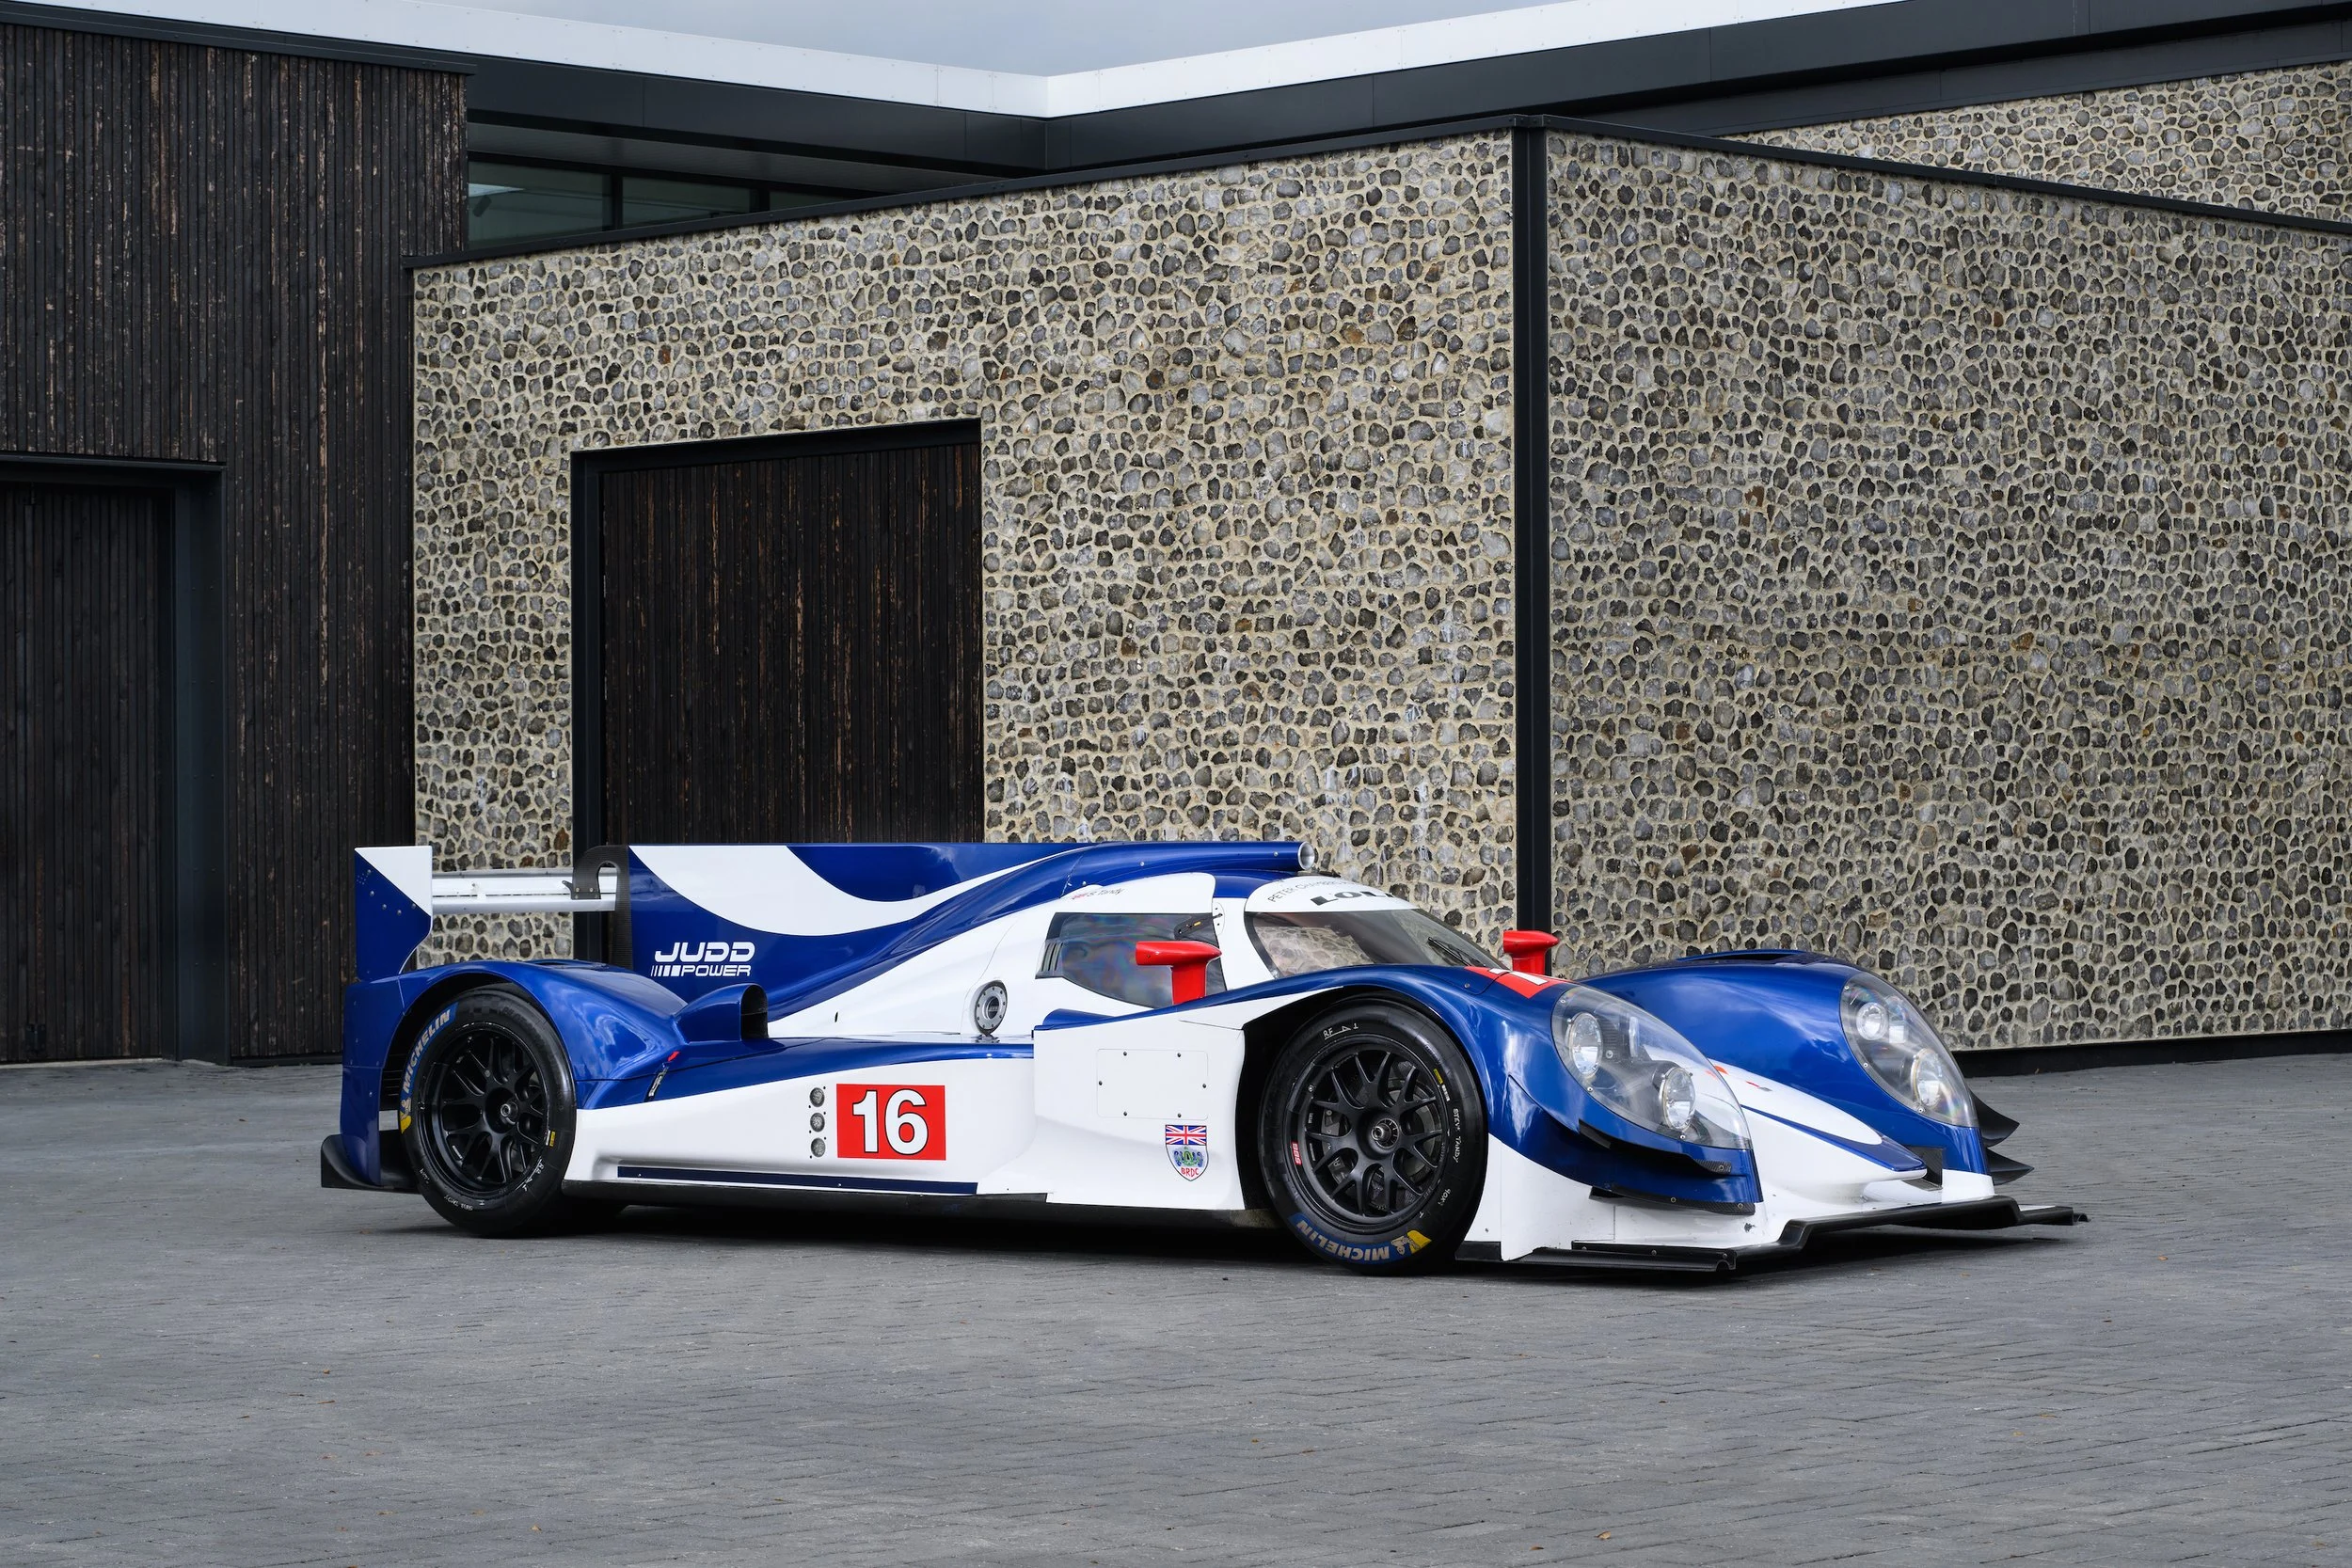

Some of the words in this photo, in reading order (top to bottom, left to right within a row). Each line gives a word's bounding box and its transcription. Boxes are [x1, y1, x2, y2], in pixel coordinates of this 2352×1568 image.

[1310, 891, 1394, 906] LOL
[654, 942, 755, 962] JUDD
[680, 964, 752, 977] POWER
[403, 1008, 451, 1094] MICHELIN
[851, 1088, 930, 1156] 16
[1453, 1135, 1462, 1164] TANDY
[1181, 1166, 1200, 1178] BRDC
[1296, 1220, 1391, 1261] MICHELIN
